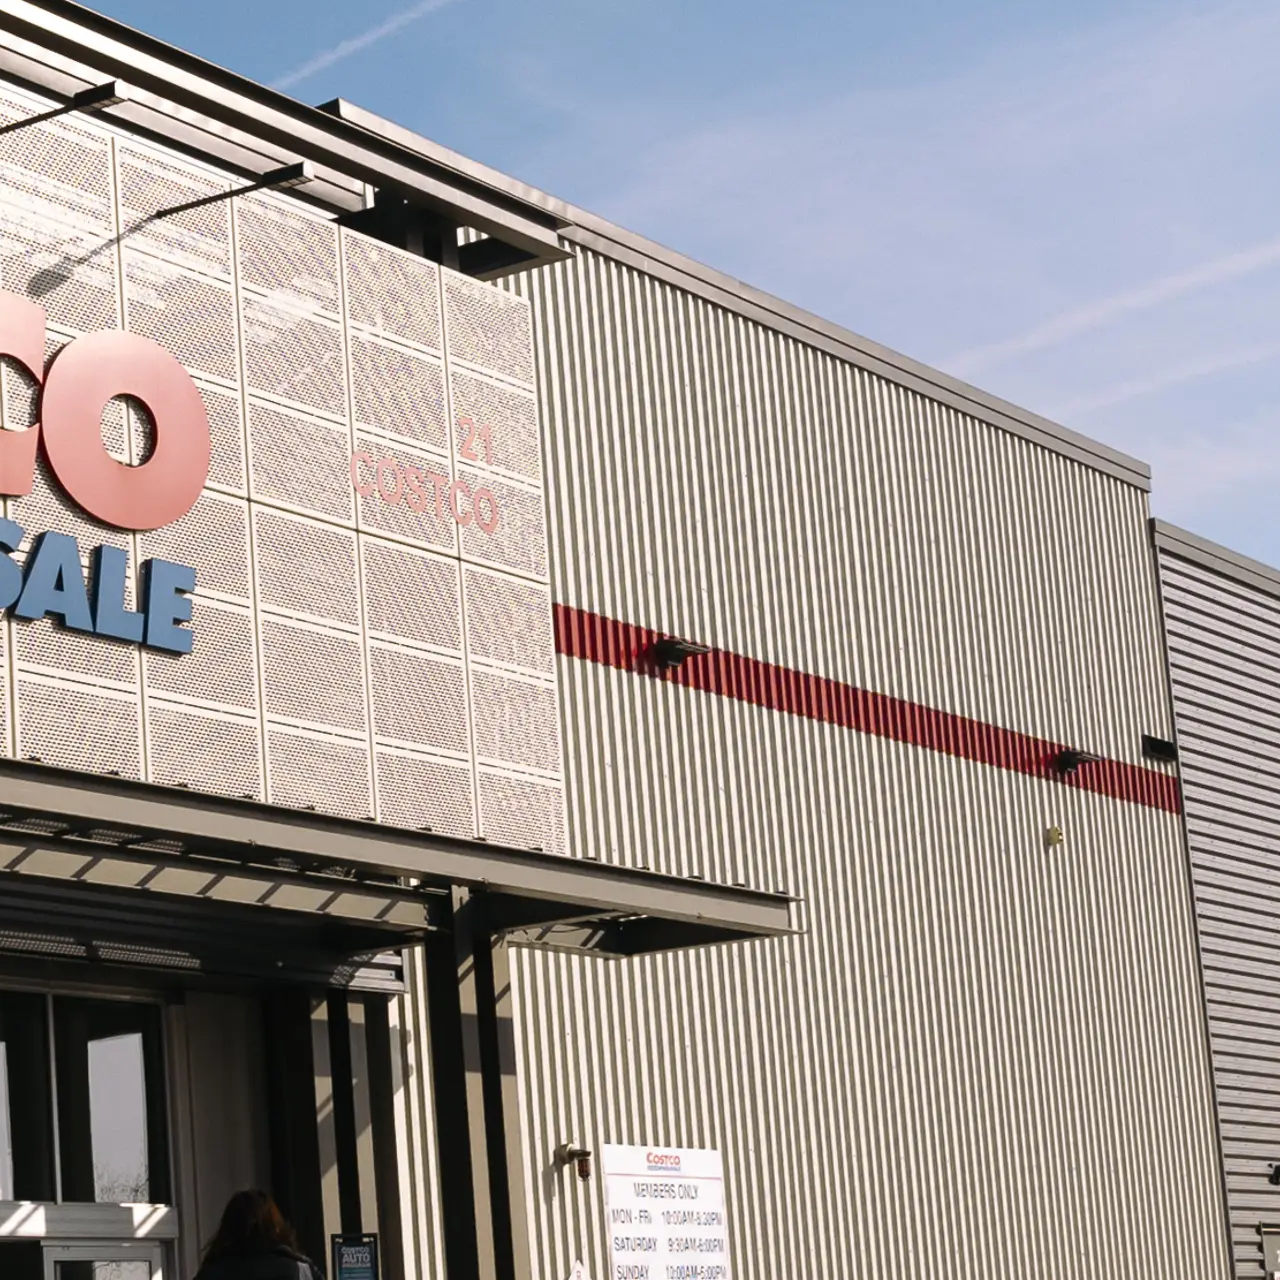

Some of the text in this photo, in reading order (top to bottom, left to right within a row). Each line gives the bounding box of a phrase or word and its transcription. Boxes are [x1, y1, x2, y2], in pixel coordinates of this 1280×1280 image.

[458, 417, 493, 465] 21
[350, 450, 500, 535] COSTCO
[646, 1152, 681, 1166] COSTCO
[633, 1182, 699, 1200] MEMBERS ONLY
[612, 1208, 632, 1224] MON
[614, 1236, 658, 1252] SATURDAY
[342, 1253, 371, 1263] AUTO
[616, 1265, 650, 1280] SUNDAY
